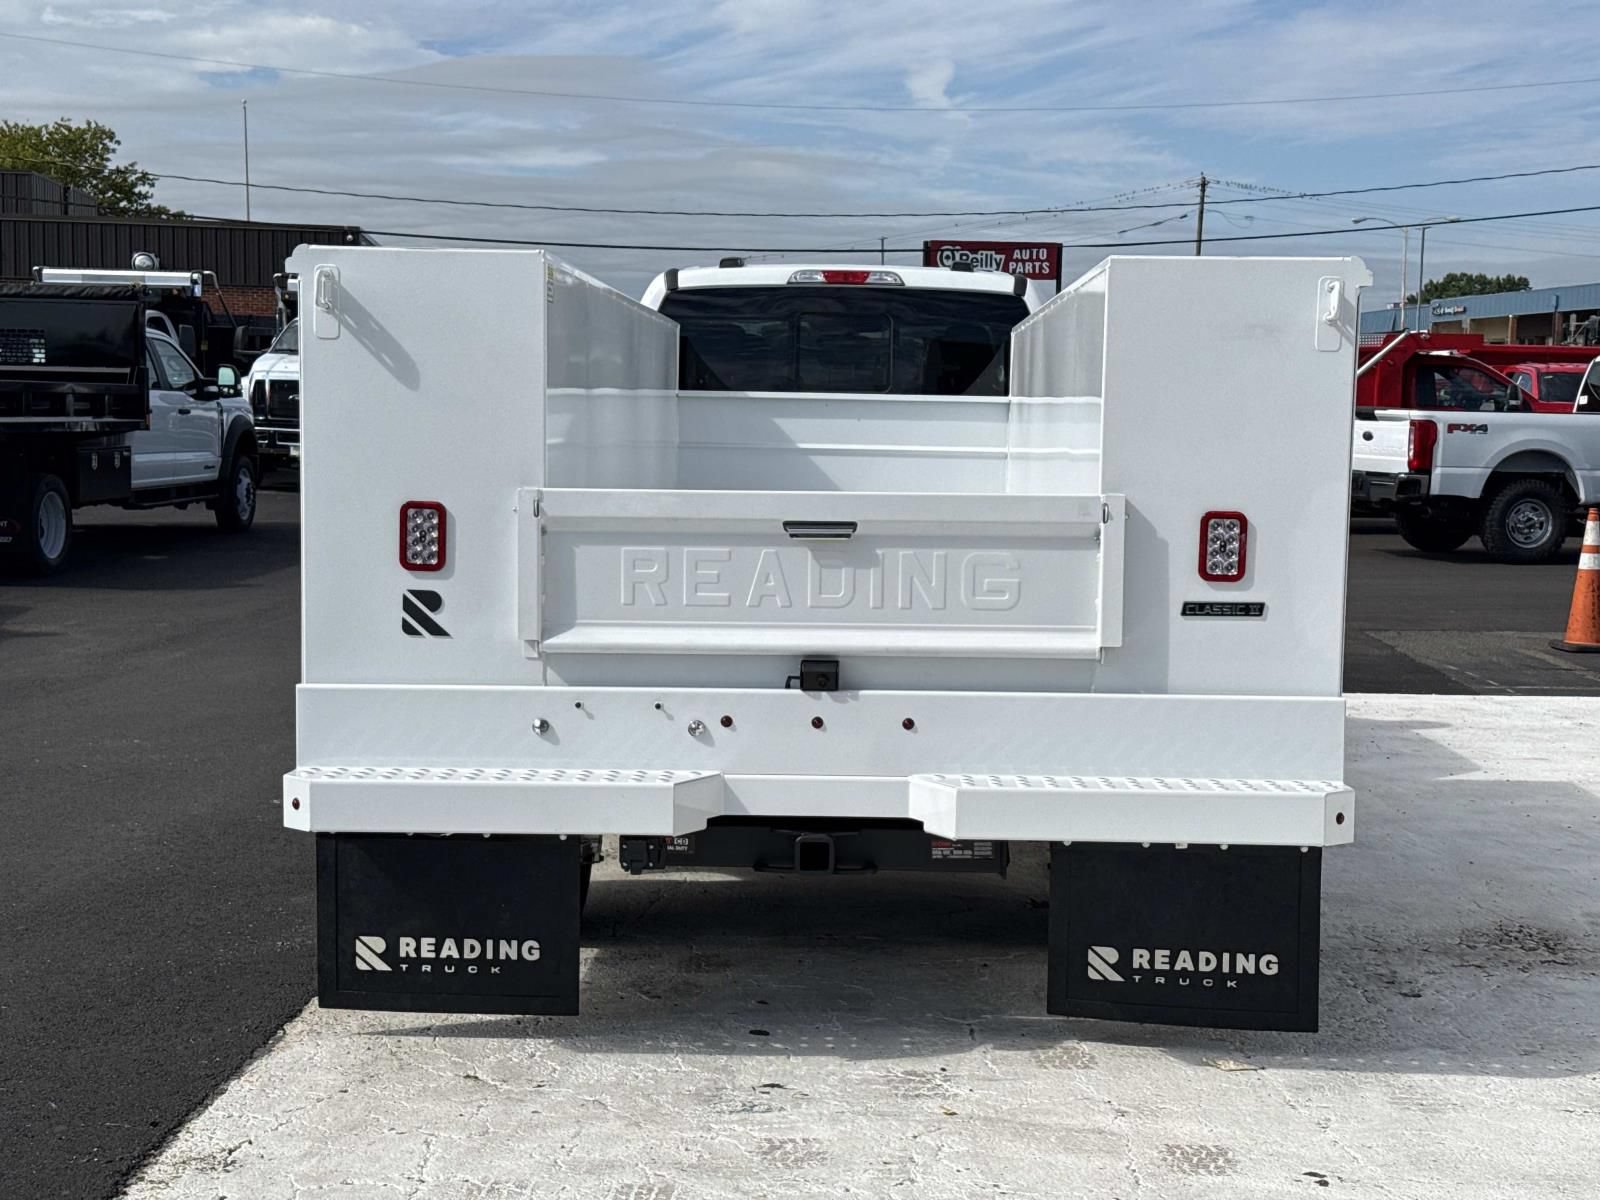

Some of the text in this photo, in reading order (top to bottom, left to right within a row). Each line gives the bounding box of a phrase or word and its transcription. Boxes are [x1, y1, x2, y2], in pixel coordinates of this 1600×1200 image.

[1013, 248, 1047, 260] AUTO
[1008, 261, 1050, 274] PARTS
[1447, 423, 1489, 433] FX4
[619, 546, 1022, 611] READING
[1184, 604, 1246, 615] CLASSIC
[399, 936, 541, 961] READING
[1132, 948, 1280, 976] READING
[400, 964, 501, 974] TRUCK
[1132, 975, 1238, 988] TRUCK
